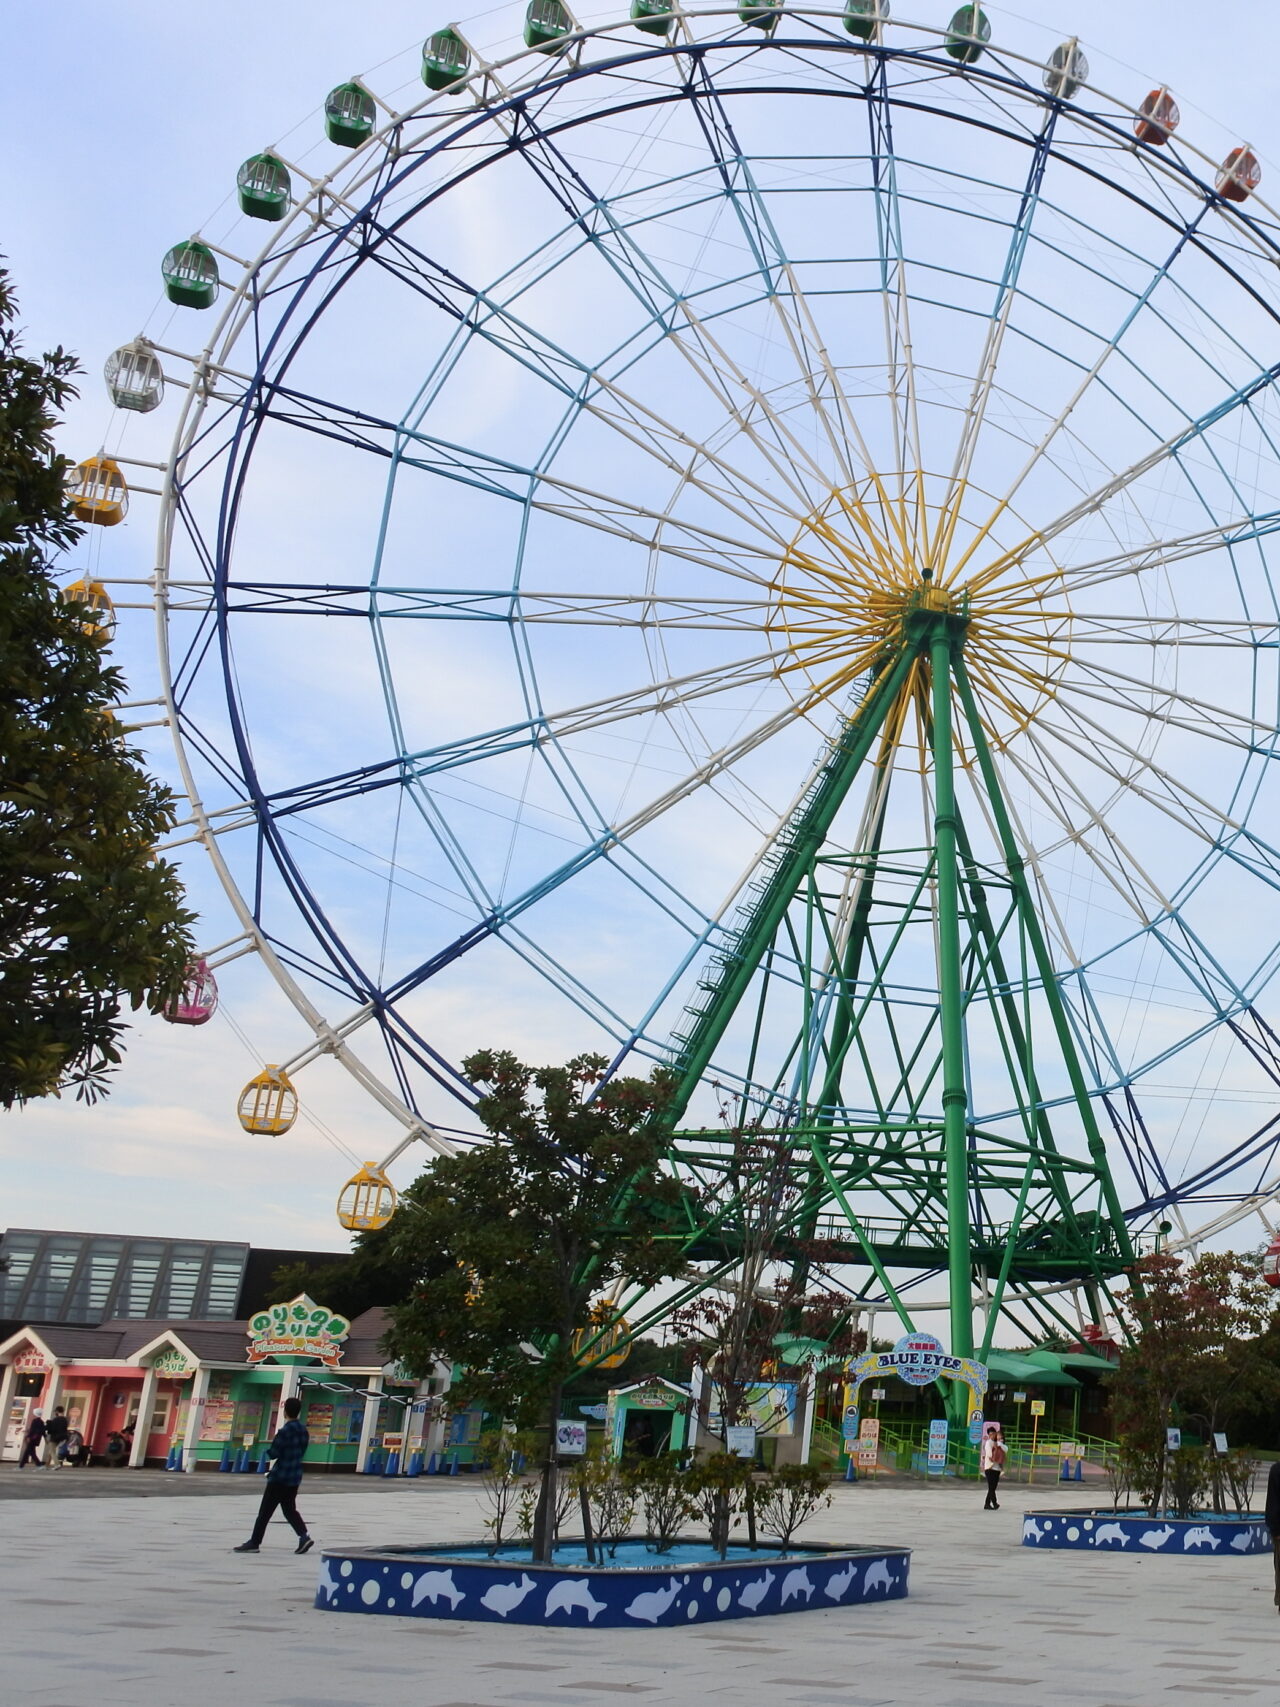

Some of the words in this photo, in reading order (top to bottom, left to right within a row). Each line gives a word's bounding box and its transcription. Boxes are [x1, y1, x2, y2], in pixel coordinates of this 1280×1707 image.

[275, 1323, 321, 1338] うりば
[255, 1341, 294, 1353] Pleasure
[305, 1343, 336, 1357] Garden
[878, 1352, 919, 1367] BLUE
[923, 1353, 962, 1371] EYES
